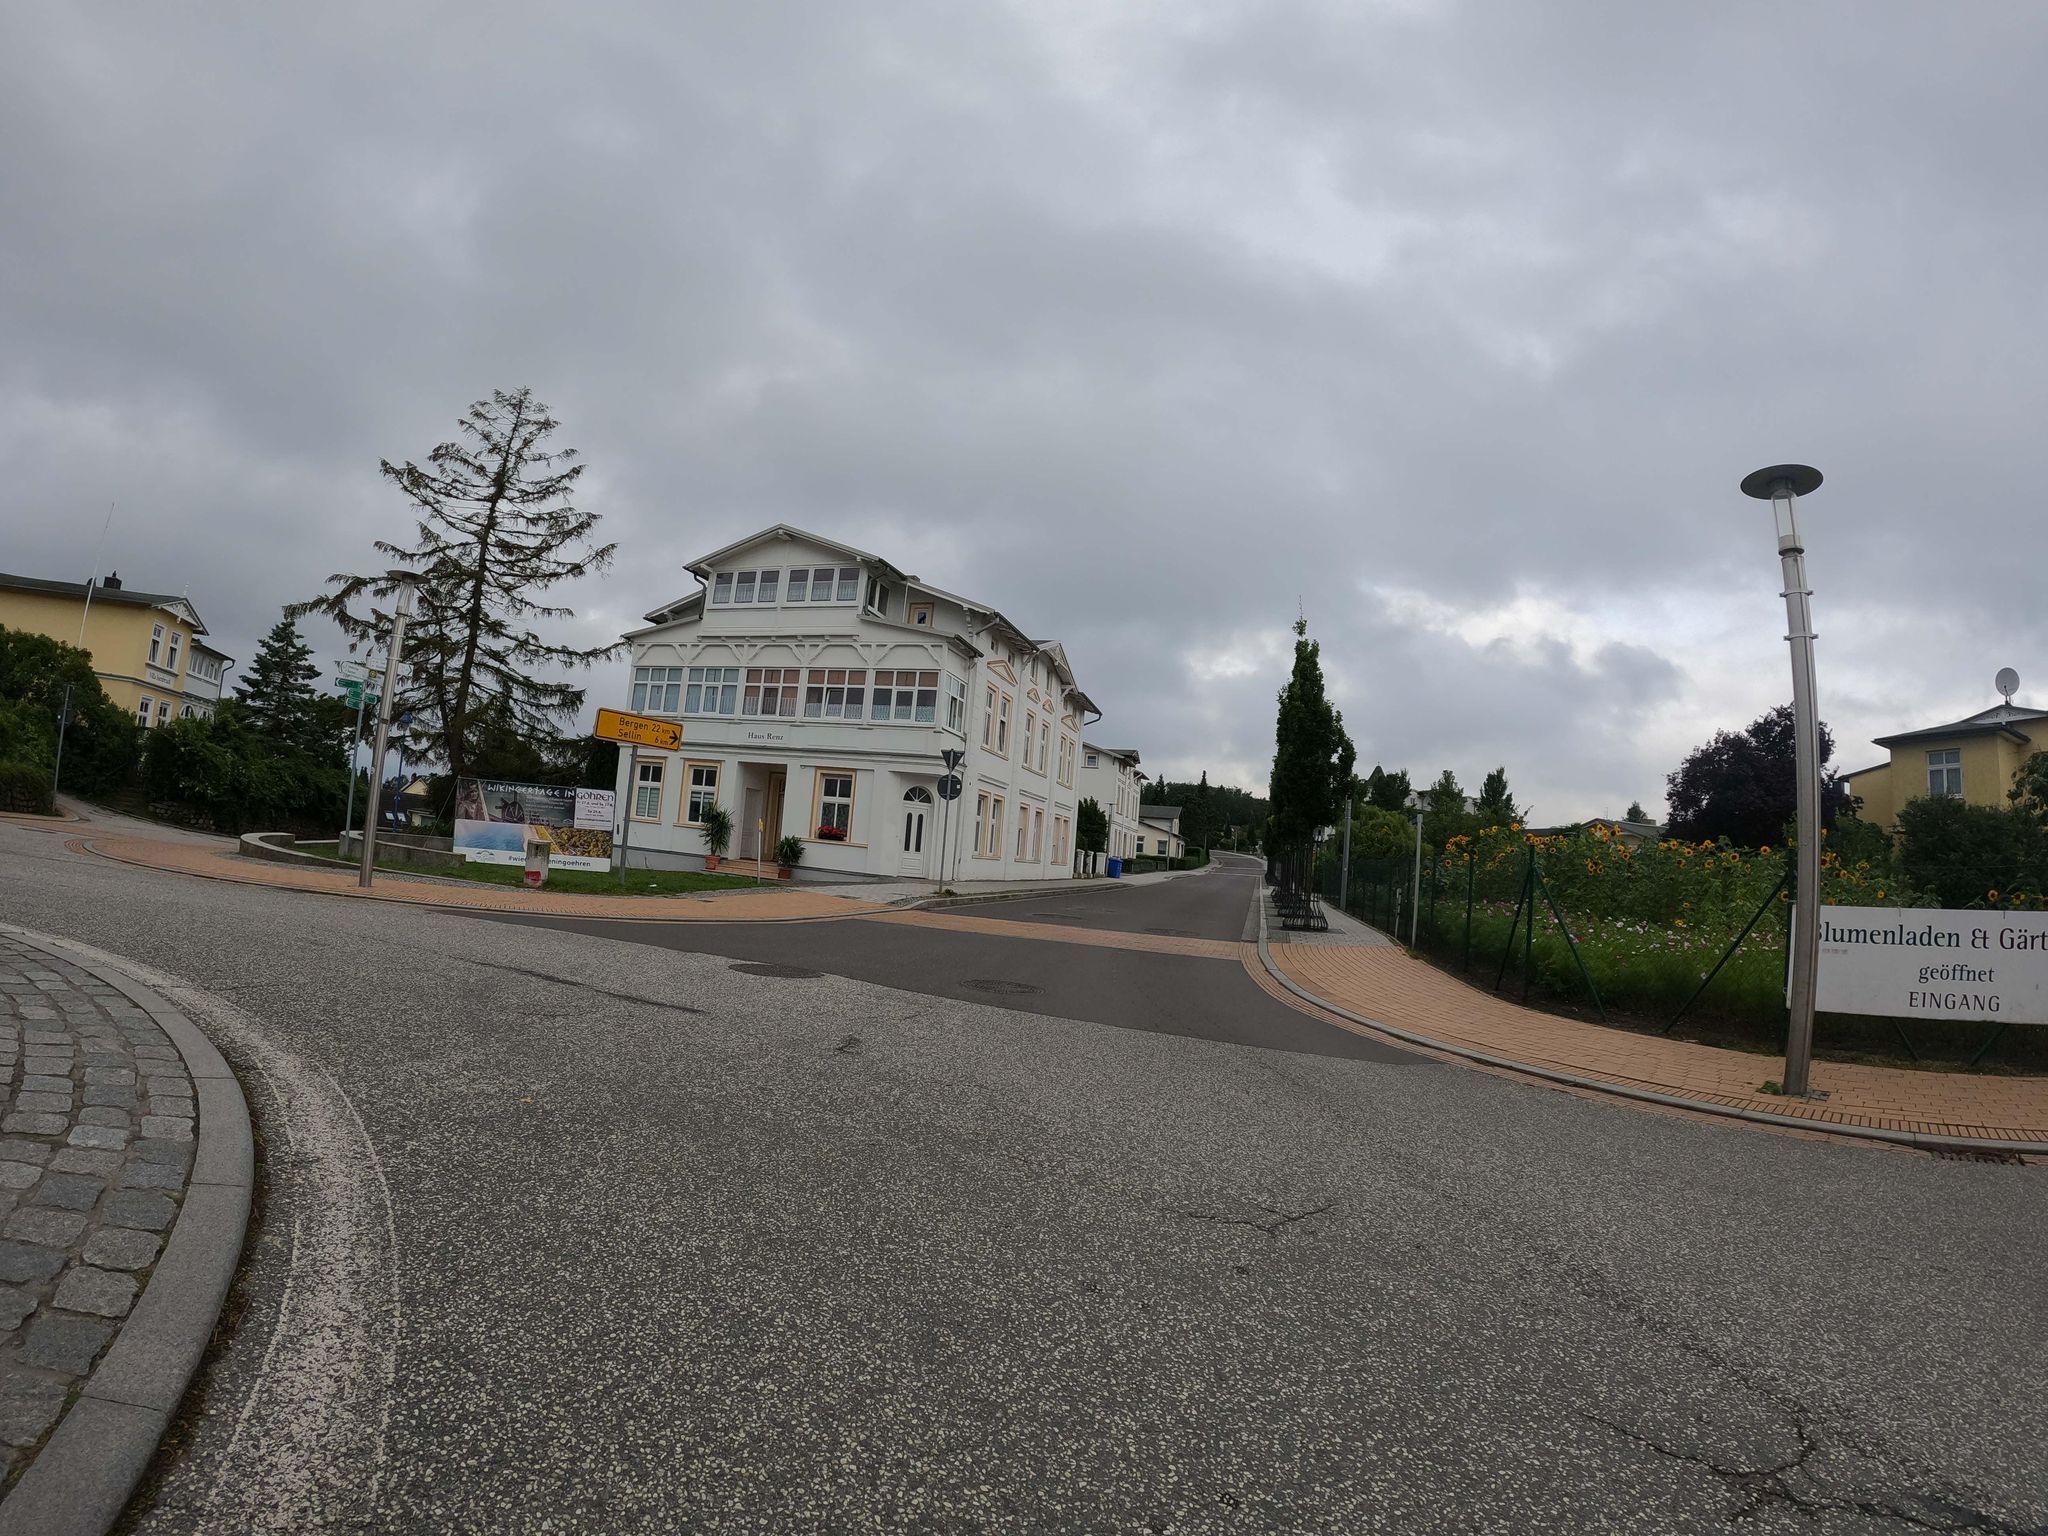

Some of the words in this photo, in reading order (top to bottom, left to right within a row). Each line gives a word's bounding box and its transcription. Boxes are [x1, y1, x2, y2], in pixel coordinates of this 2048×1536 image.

[619, 717, 648, 730] Bergen
[651, 723, 661, 733] 22
[618, 729, 642, 740] Sellin
[655, 736, 659, 744] 6
[660, 738, 669, 746] km
[748, 731, 765, 739] Haus
[564, 790, 575, 798] IN
[1818, 921, 1961, 948] lumenladen
[1971, 927, 1990, 950] &
[1918, 964, 1995, 984] geöffnet
[1909, 991, 2001, 1012] EINGANG
